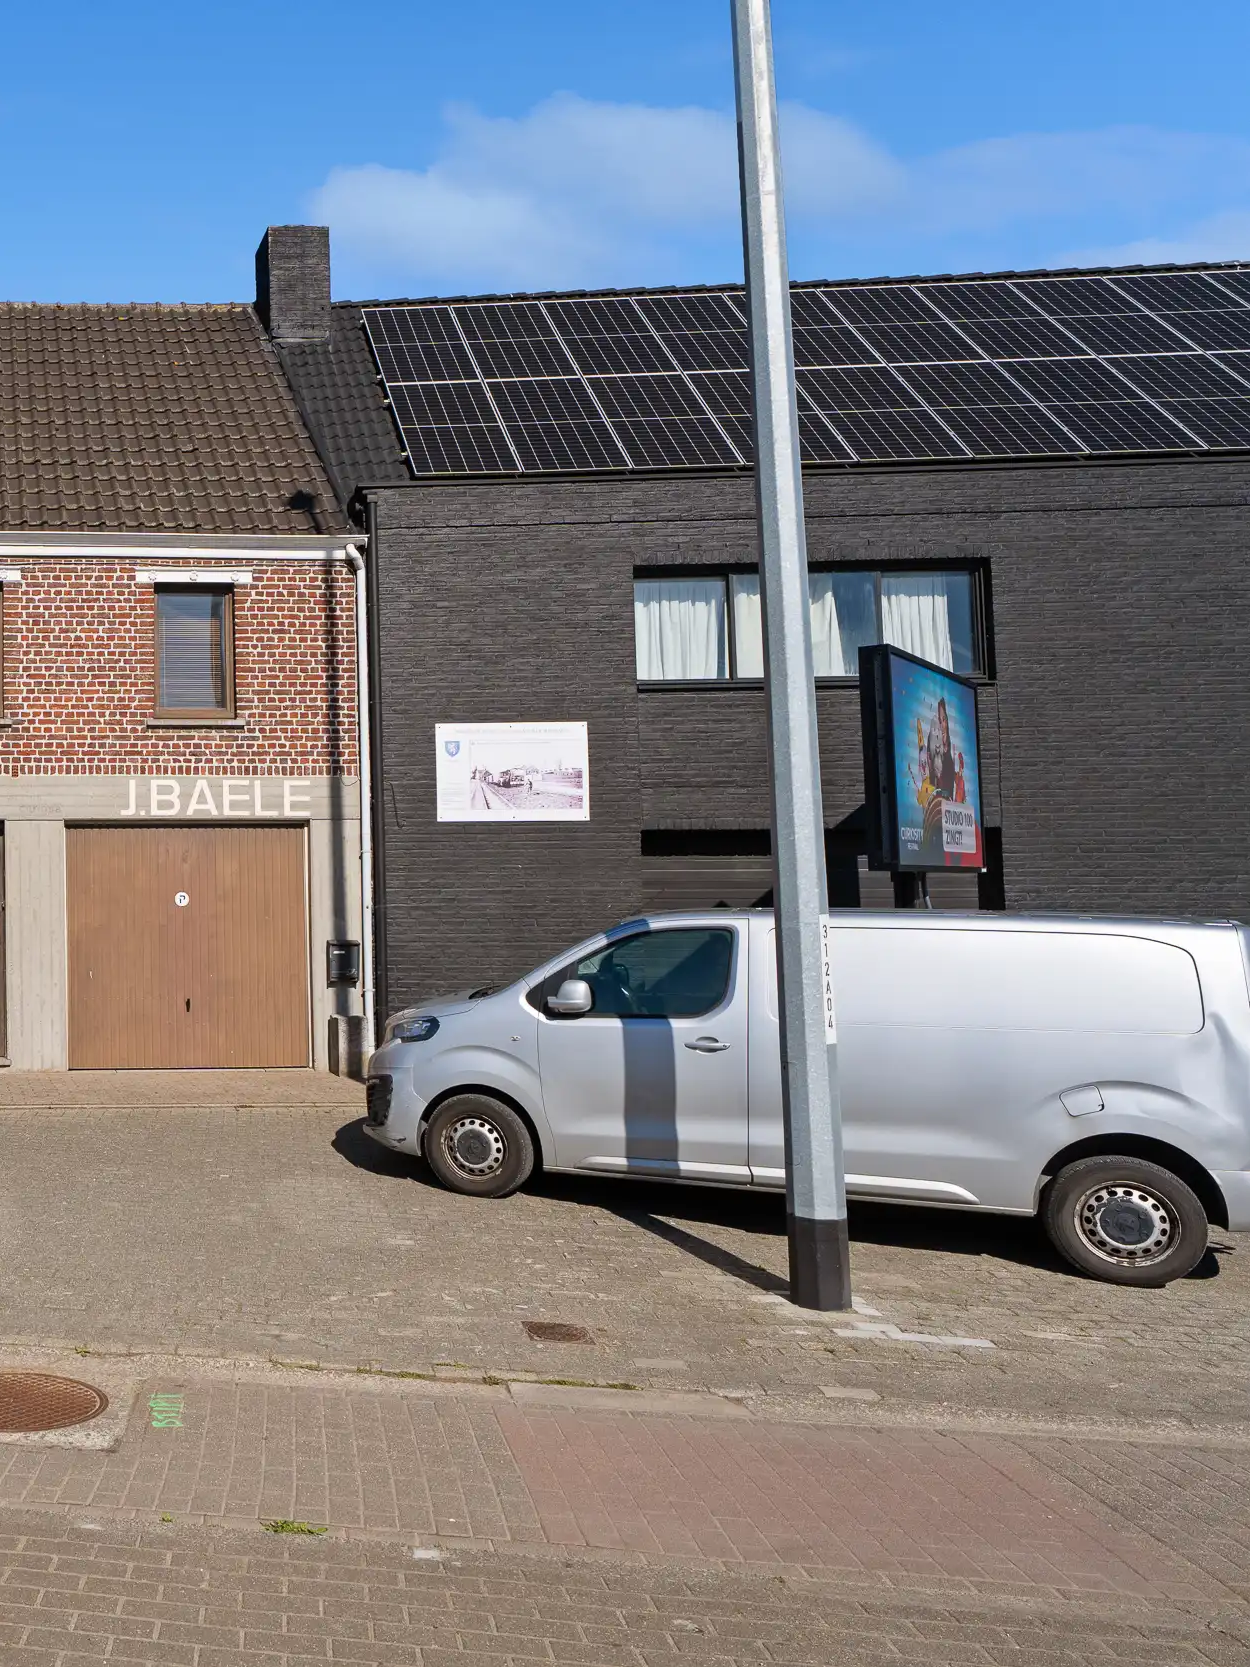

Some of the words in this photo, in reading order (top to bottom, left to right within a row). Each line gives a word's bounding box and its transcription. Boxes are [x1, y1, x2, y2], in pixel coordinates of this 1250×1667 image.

[120, 779, 311, 817] J.BAELE
[945, 810, 964, 826] STUDIO
[964, 812, 973, 828] 100
[945, 830, 963, 846] ZINGT!
